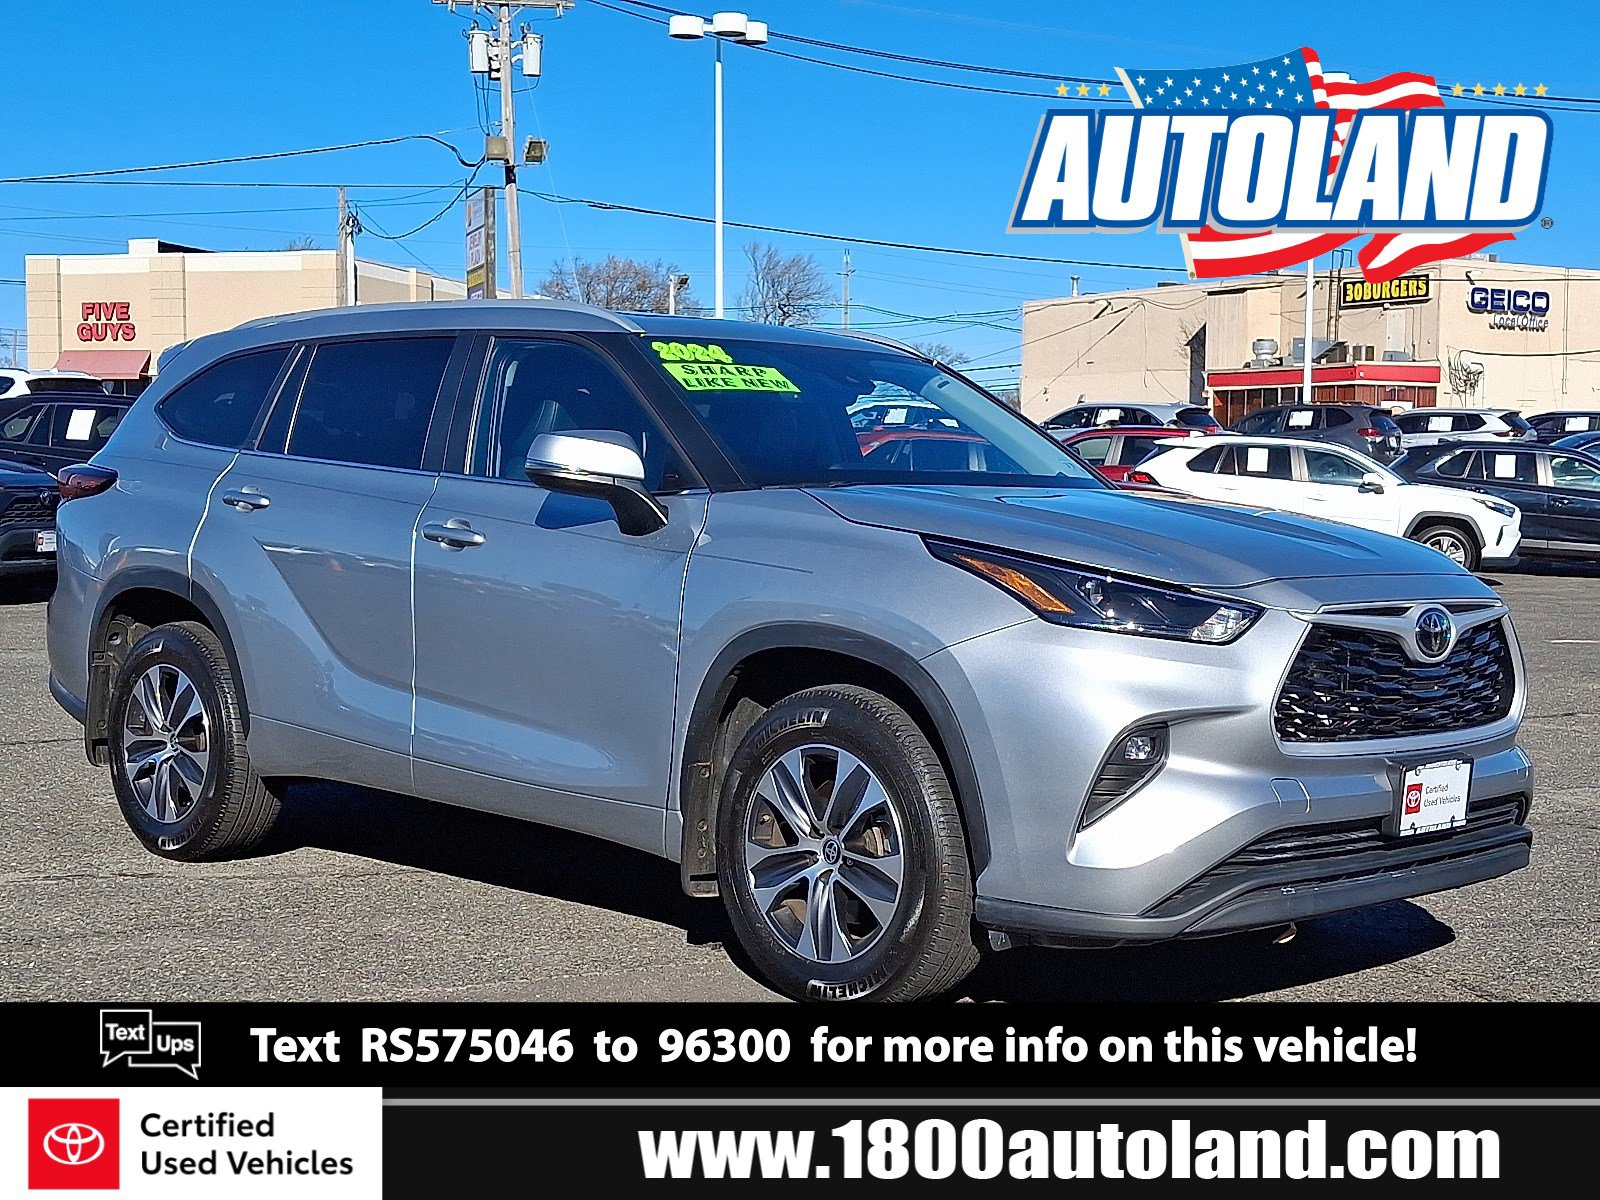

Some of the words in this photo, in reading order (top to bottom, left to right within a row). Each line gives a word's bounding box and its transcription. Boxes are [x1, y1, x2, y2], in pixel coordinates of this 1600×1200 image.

[1470, 287, 1550, 313] GEICO
[82, 302, 130, 321] FIVE
[77, 323, 136, 342] GUYS
[651, 341, 733, 363] 2024
[681, 365, 767, 377] SHARP
[681, 377, 738, 388] LIKE
[740, 379, 790, 389] NEW
[807, 964, 891, 1000] MICHELIN
